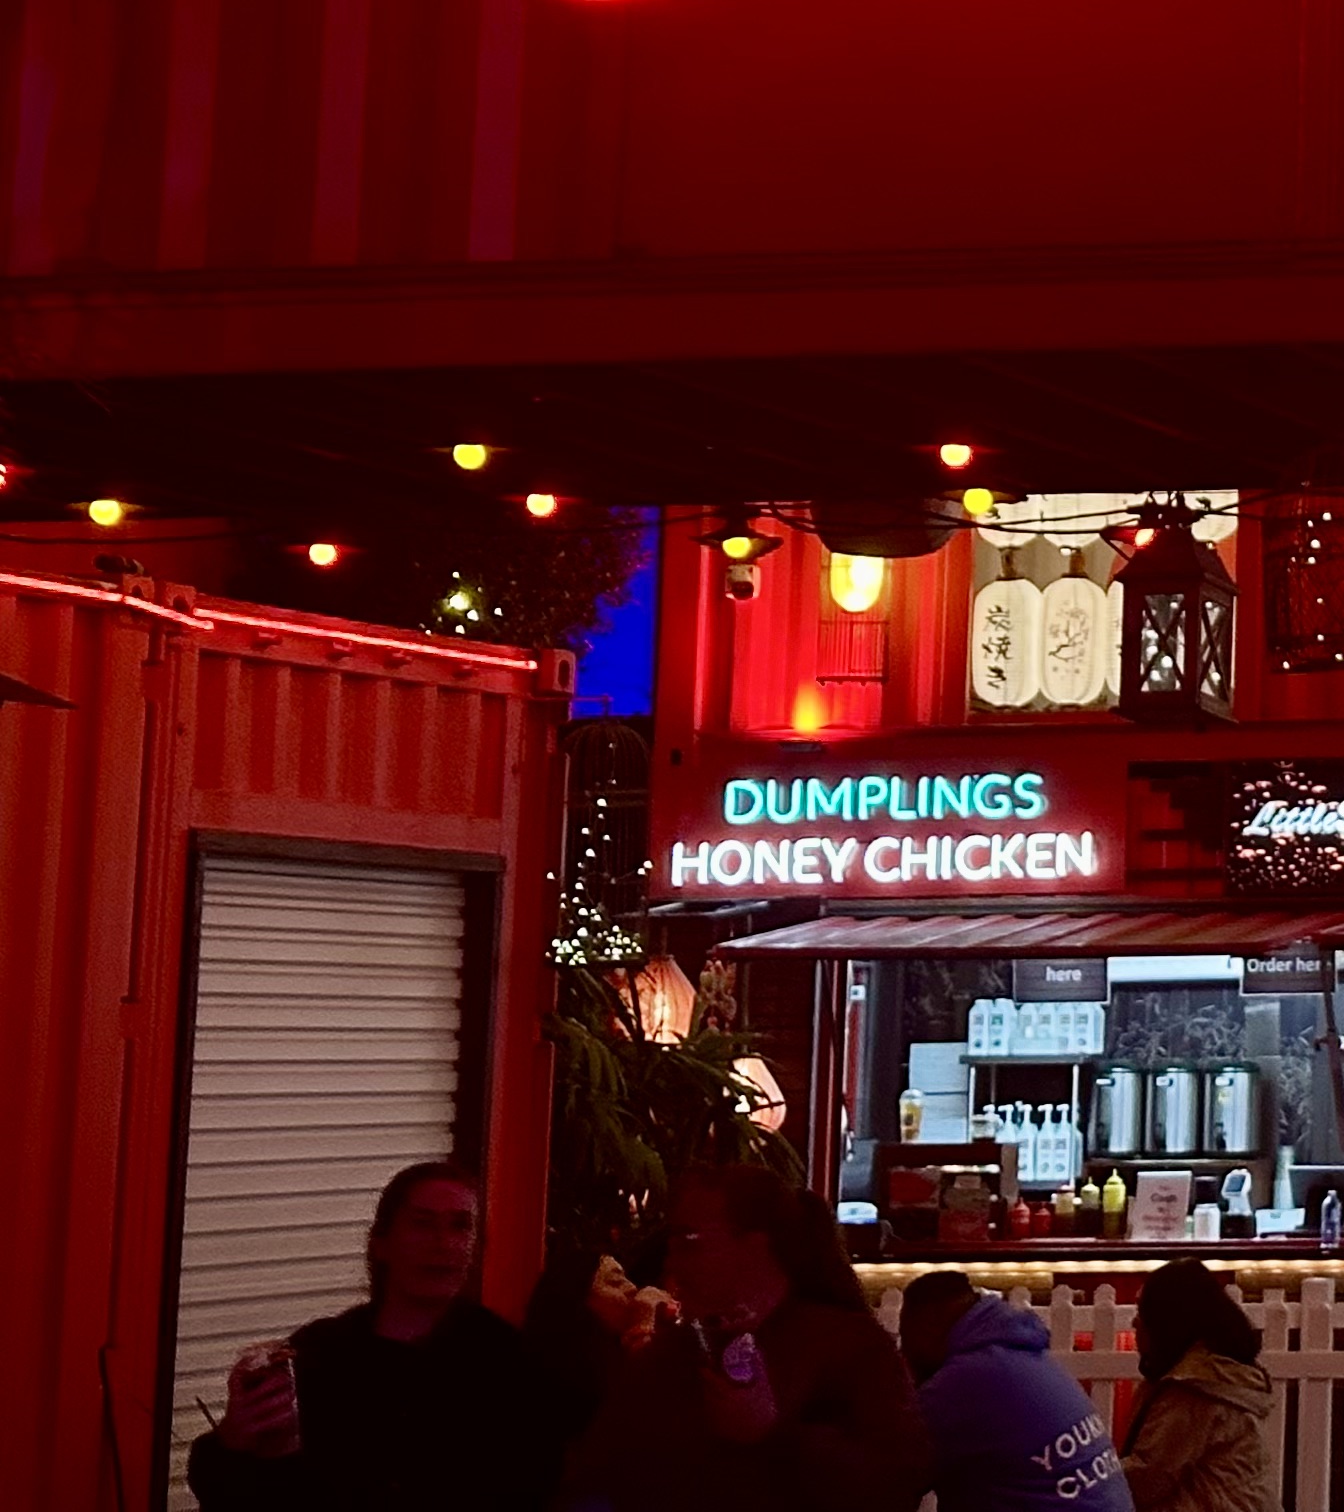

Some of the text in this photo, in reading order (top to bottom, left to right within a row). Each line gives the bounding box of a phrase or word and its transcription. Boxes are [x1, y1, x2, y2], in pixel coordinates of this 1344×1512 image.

[723, 773, 1046, 826] DUMPLINGS
[671, 830, 1099, 888] HONEY CHICKEN
[1046, 965, 1083, 983] here
[1246, 957, 1291, 974] Order
